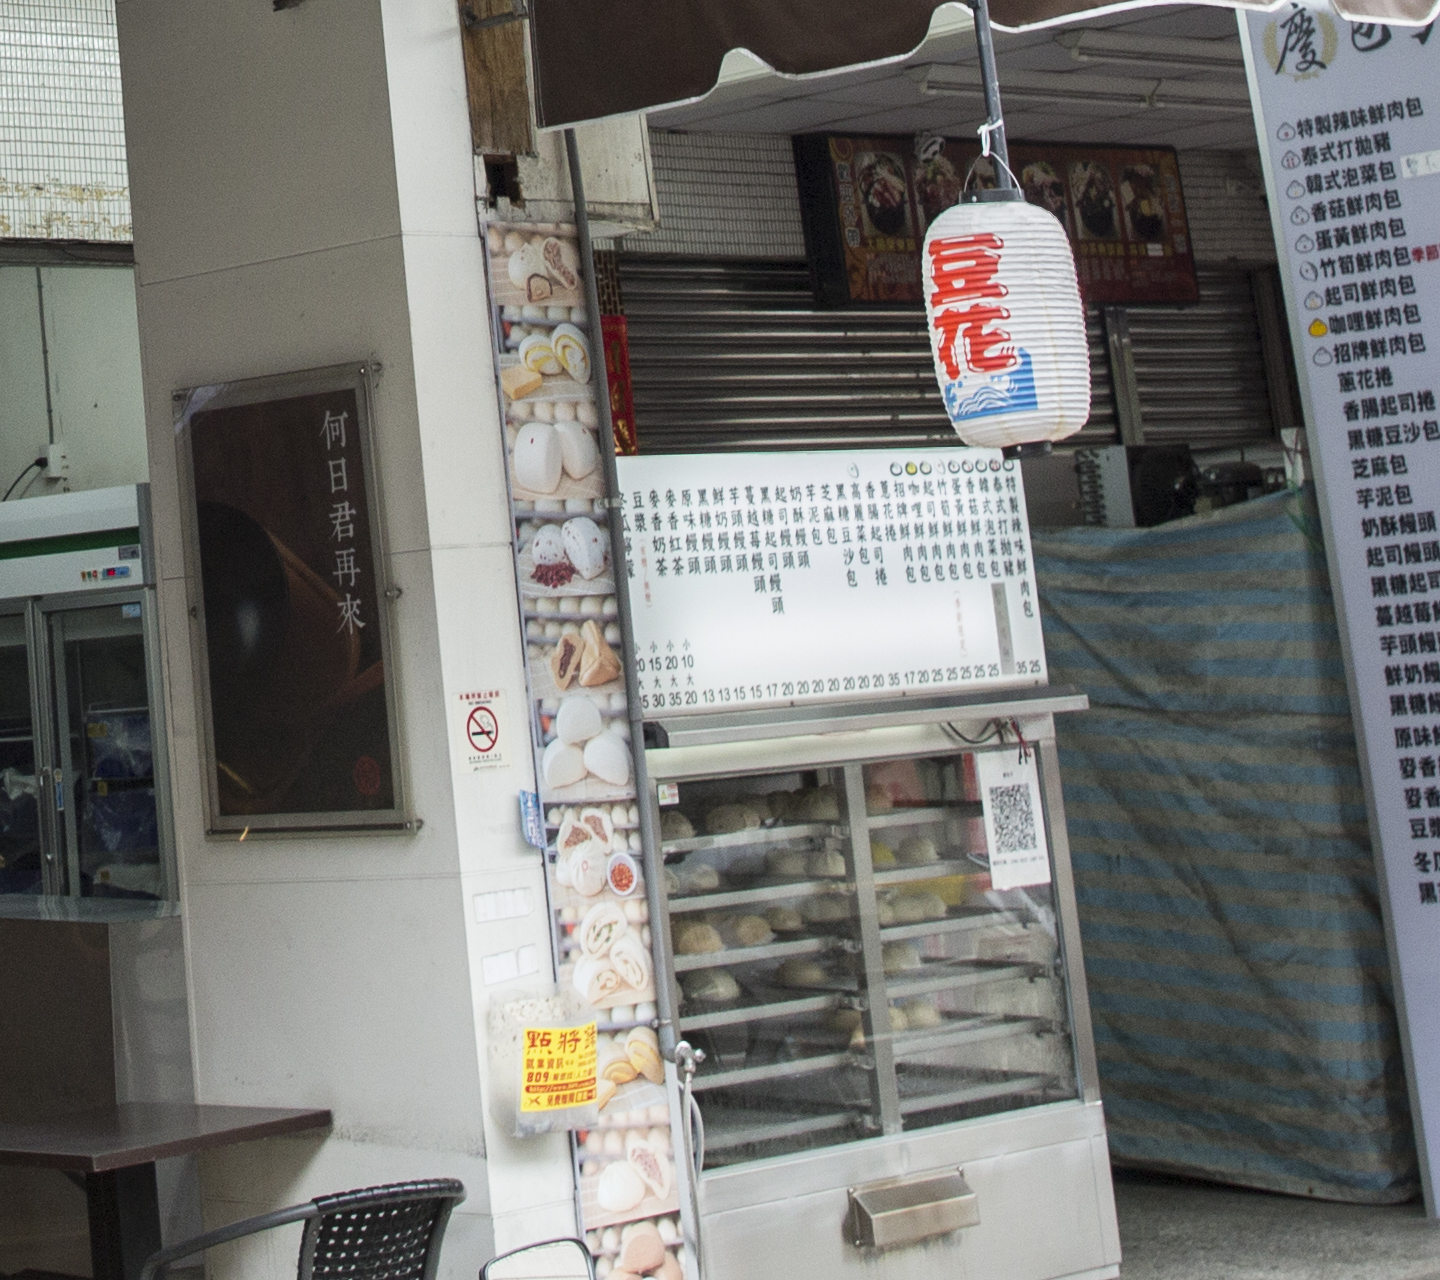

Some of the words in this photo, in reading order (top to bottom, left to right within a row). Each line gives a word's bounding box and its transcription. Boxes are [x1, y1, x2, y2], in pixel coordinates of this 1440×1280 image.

[1297, 97, 1423, 138] 特製辣味鮮肉包
[1306, 161, 1396, 194] 韓式泡菜包
[1311, 189, 1401, 222] 香菇鮮肉包
[1315, 218, 1406, 251] 蛋黃鮮肉包
[1320, 246, 1412, 278] 竹筍鮮肉包
[927, 232, 1016, 380] 豆花
[1325, 275, 1416, 308] 起司鮮肉包
[1333, 332, 1426, 364] 招牌鮮肉包
[1343, 390, 1436, 422] 香腸起司捲
[1347, 420, 1440, 450] 黑糖豆沙包
[1352, 454, 1408, 480] 芝麻包
[1356, 484, 1413, 509] 芋泥包
[320, 408, 366, 636] 何日君再來
[821, 483, 838, 545] 芝麻包
[1361, 511, 1437, 538] 奶酥饅頭
[649, 657, 661, 671] 15
[719, 688, 730, 701] 13
[828, 678, 839, 692] 20
[918, 670, 929, 683] 20
[1030, 660, 1041, 673] 25
[527, 1071, 549, 1083] 809
